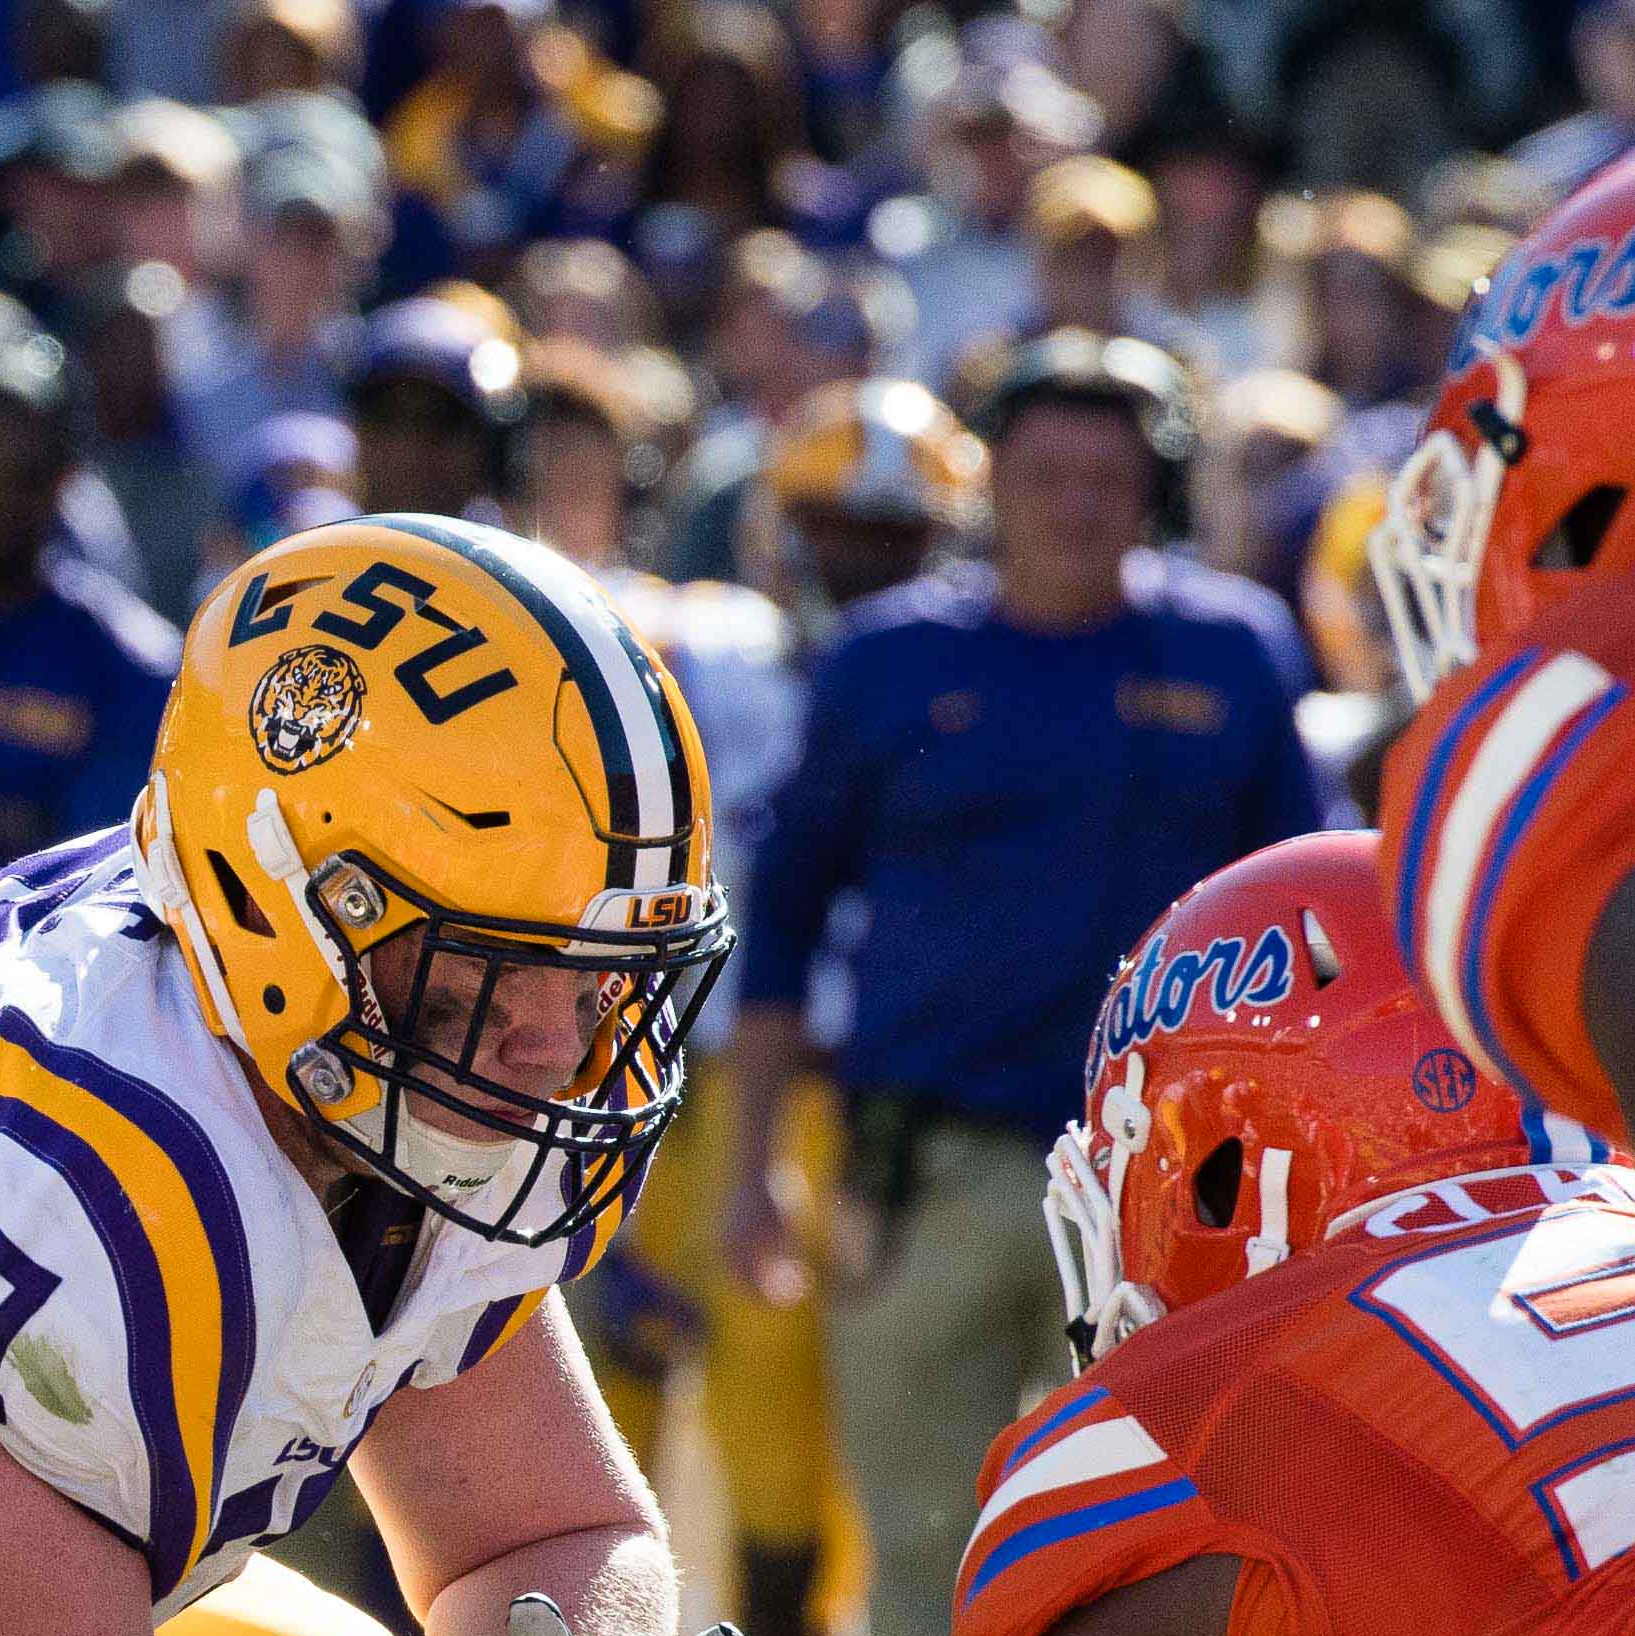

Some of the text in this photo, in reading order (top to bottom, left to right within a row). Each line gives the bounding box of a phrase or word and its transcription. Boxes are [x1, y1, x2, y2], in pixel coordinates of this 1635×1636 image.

[228, 561, 518, 725] LSU
[625, 890, 693, 930] LSU
[1086, 924, 1295, 1094] ators
